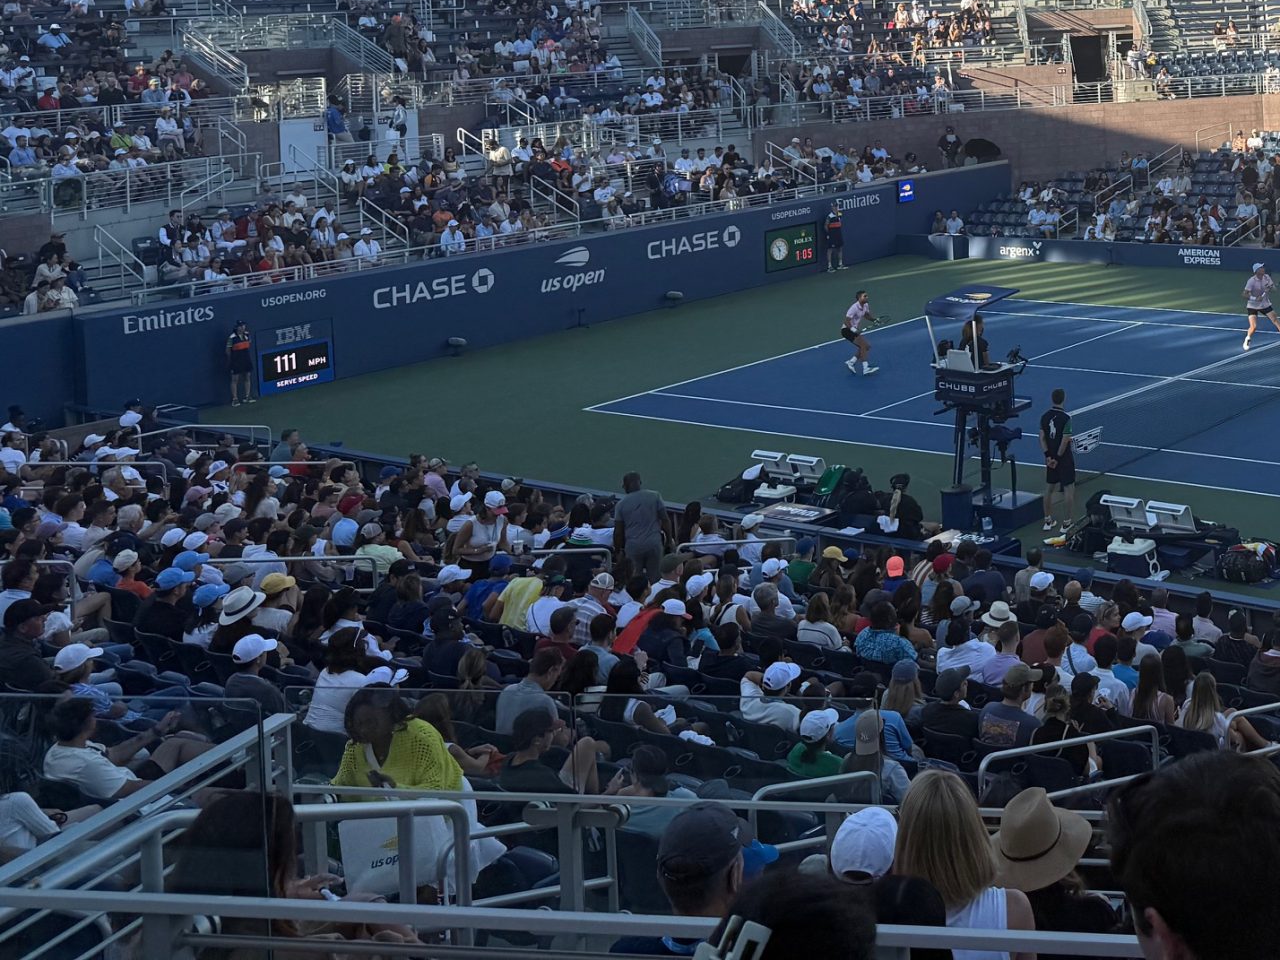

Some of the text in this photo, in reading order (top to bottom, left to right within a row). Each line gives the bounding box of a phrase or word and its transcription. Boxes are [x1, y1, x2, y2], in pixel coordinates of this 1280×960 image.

[836, 194, 880, 211] Emirates
[771, 207, 811, 220] USOPEN.ORG
[647, 230, 719, 259] CHASE
[1000, 246, 1034, 258] argenx
[795, 248, 813, 260] 1:05
[1178, 248, 1220, 257] AMERICAN
[1184, 256, 1221, 265] EXPRESS
[541, 268, 605, 293] us open
[261, 289, 327, 307] USOPEN.ORG
[373, 274, 467, 309] CHASE
[123, 305, 214, 334] Emirates
[275, 324, 312, 345] IBM
[274, 352, 326, 373] 111 MPH
[276, 373, 318, 388] SERVE SPEED
[938, 381, 976, 393] CHUBB
[982, 380, 1008, 392] CHUBB
[371, 858, 384, 869] us
